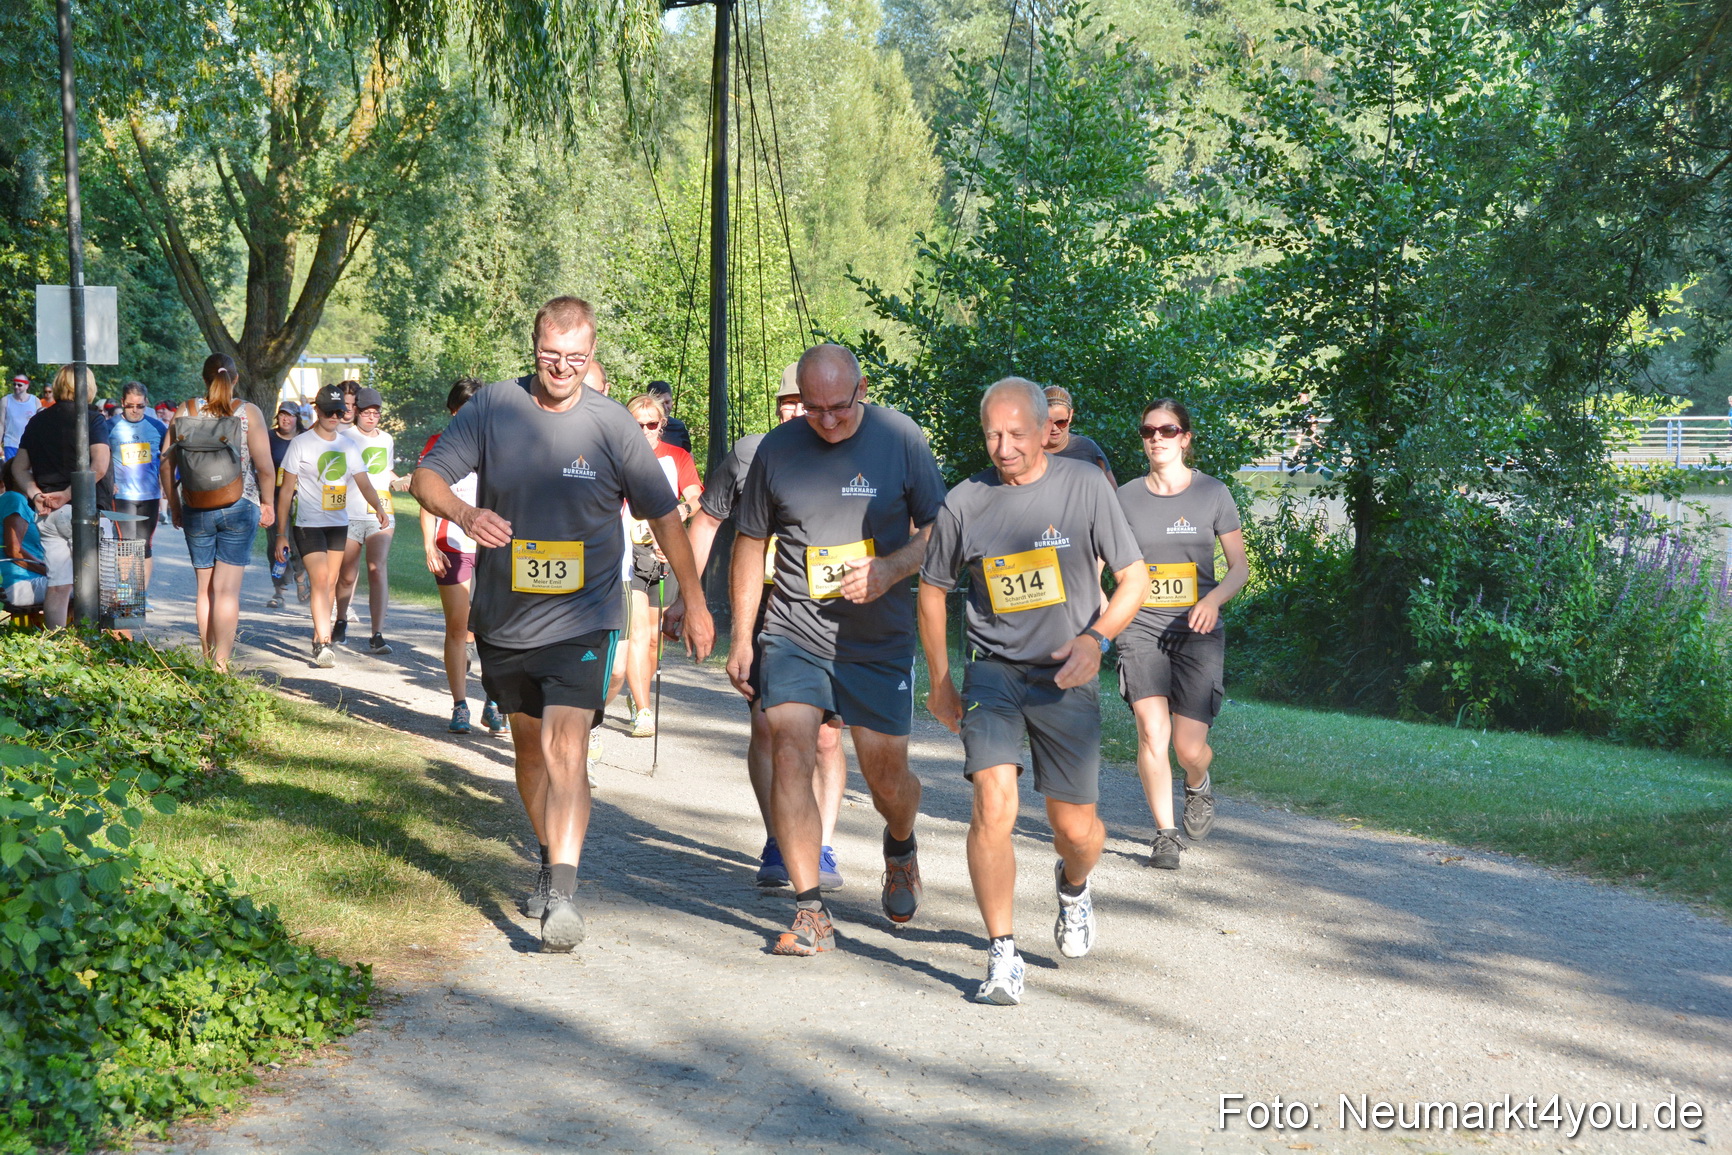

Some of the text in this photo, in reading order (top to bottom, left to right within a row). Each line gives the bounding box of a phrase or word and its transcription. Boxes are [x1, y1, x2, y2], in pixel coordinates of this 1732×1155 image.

[563, 467, 596, 477] BURKHARDT
[1034, 538, 1070, 548] BURKHARDT
[527, 559, 567, 579] 313
[822, 563, 846, 583] 31
[1000, 570, 1044, 596] 314
[1151, 579, 1183, 594] 310
[1004, 594, 1026, 602] Schardt
